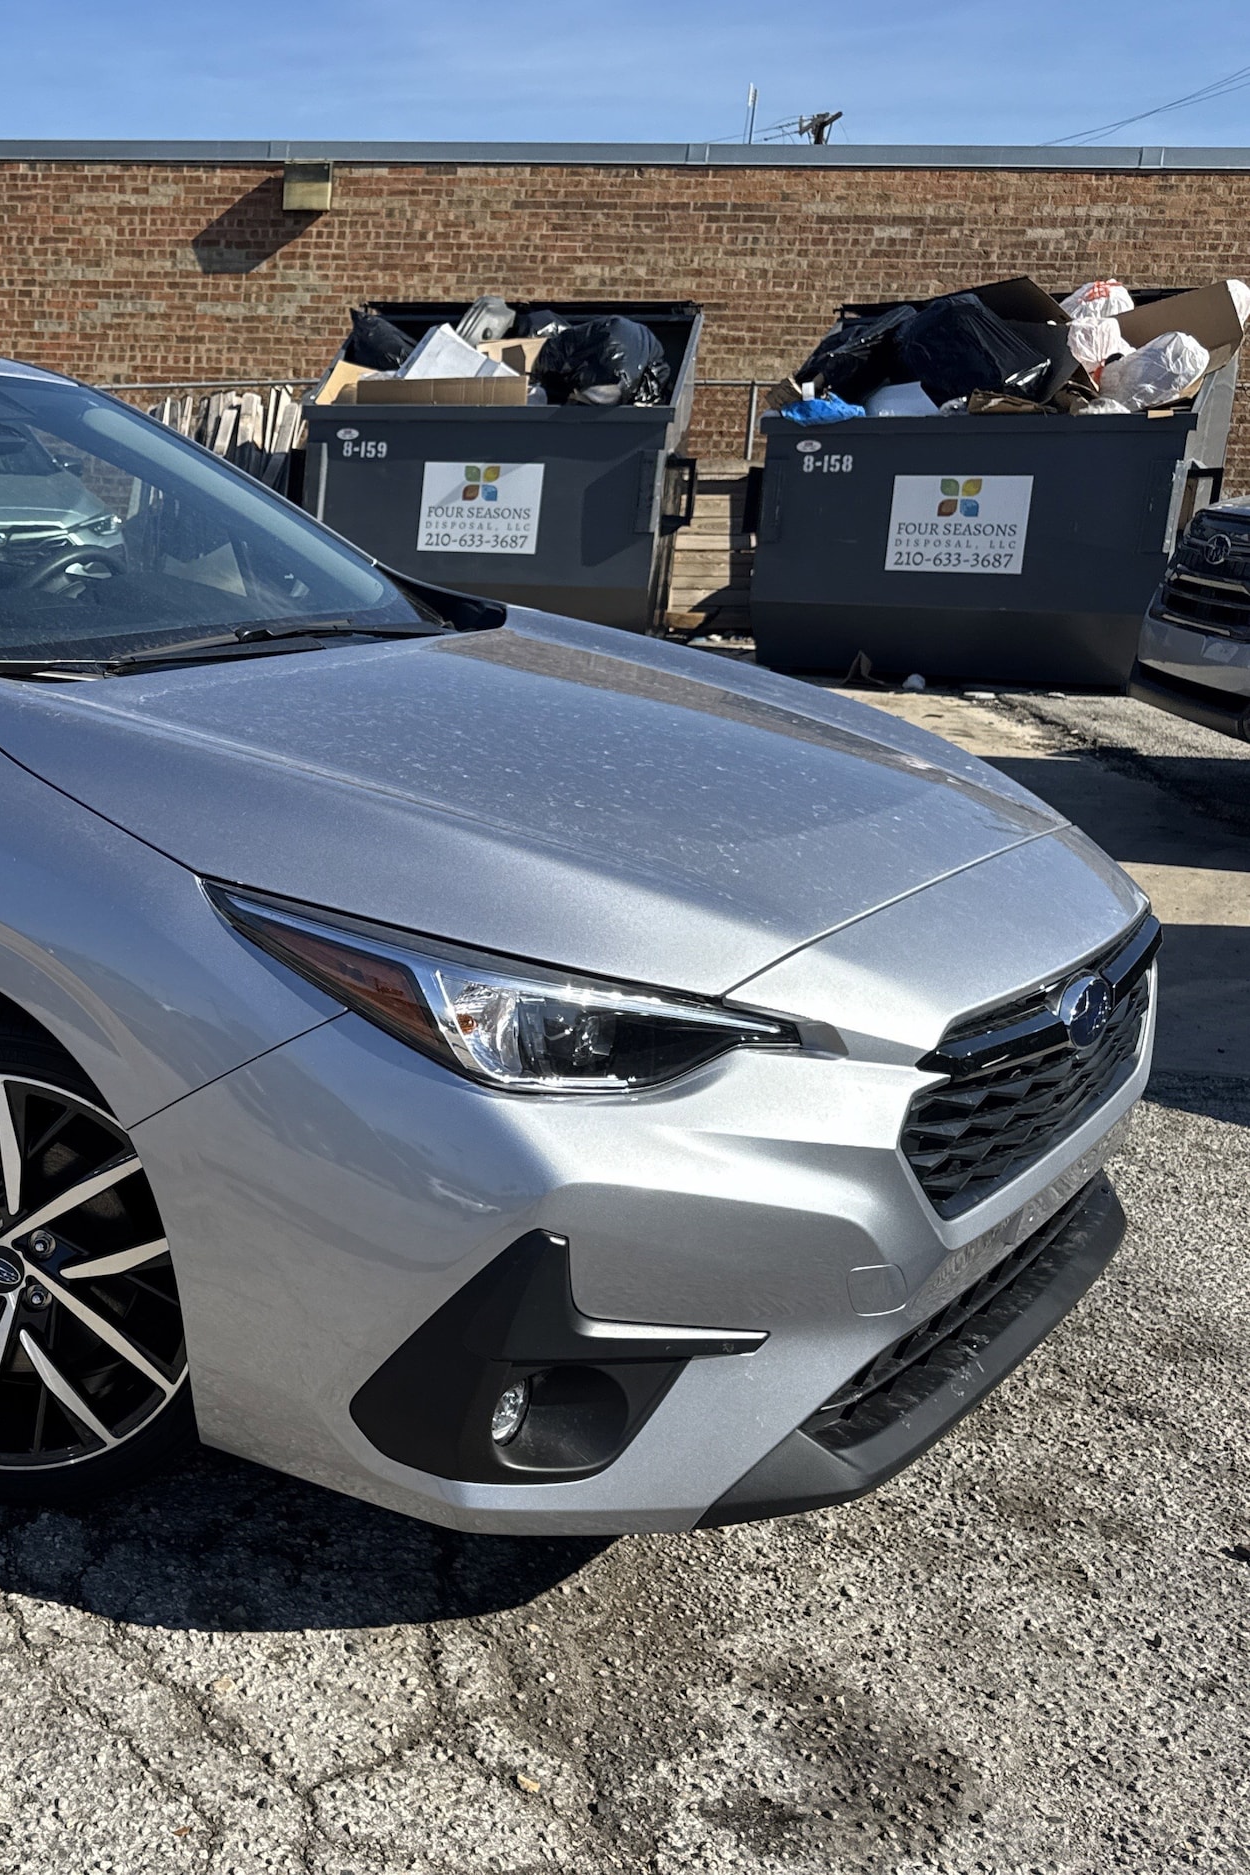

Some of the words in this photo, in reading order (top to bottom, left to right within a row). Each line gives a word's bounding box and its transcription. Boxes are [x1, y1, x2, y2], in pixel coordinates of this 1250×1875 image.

[342, 441, 388, 459] 8-159
[802, 454, 853, 473] 8-158
[427, 506, 464, 519] FOUR
[466, 507, 531, 520] SEASONS
[506, 523, 531, 532] LLC
[896, 522, 939, 535] FOUR
[942, 522, 1018, 537] SEASONS
[425, 532, 529, 549] 210-633-3687
[989, 540, 1017, 550] LLC
[893, 551, 1014, 569] 210-633-3687
